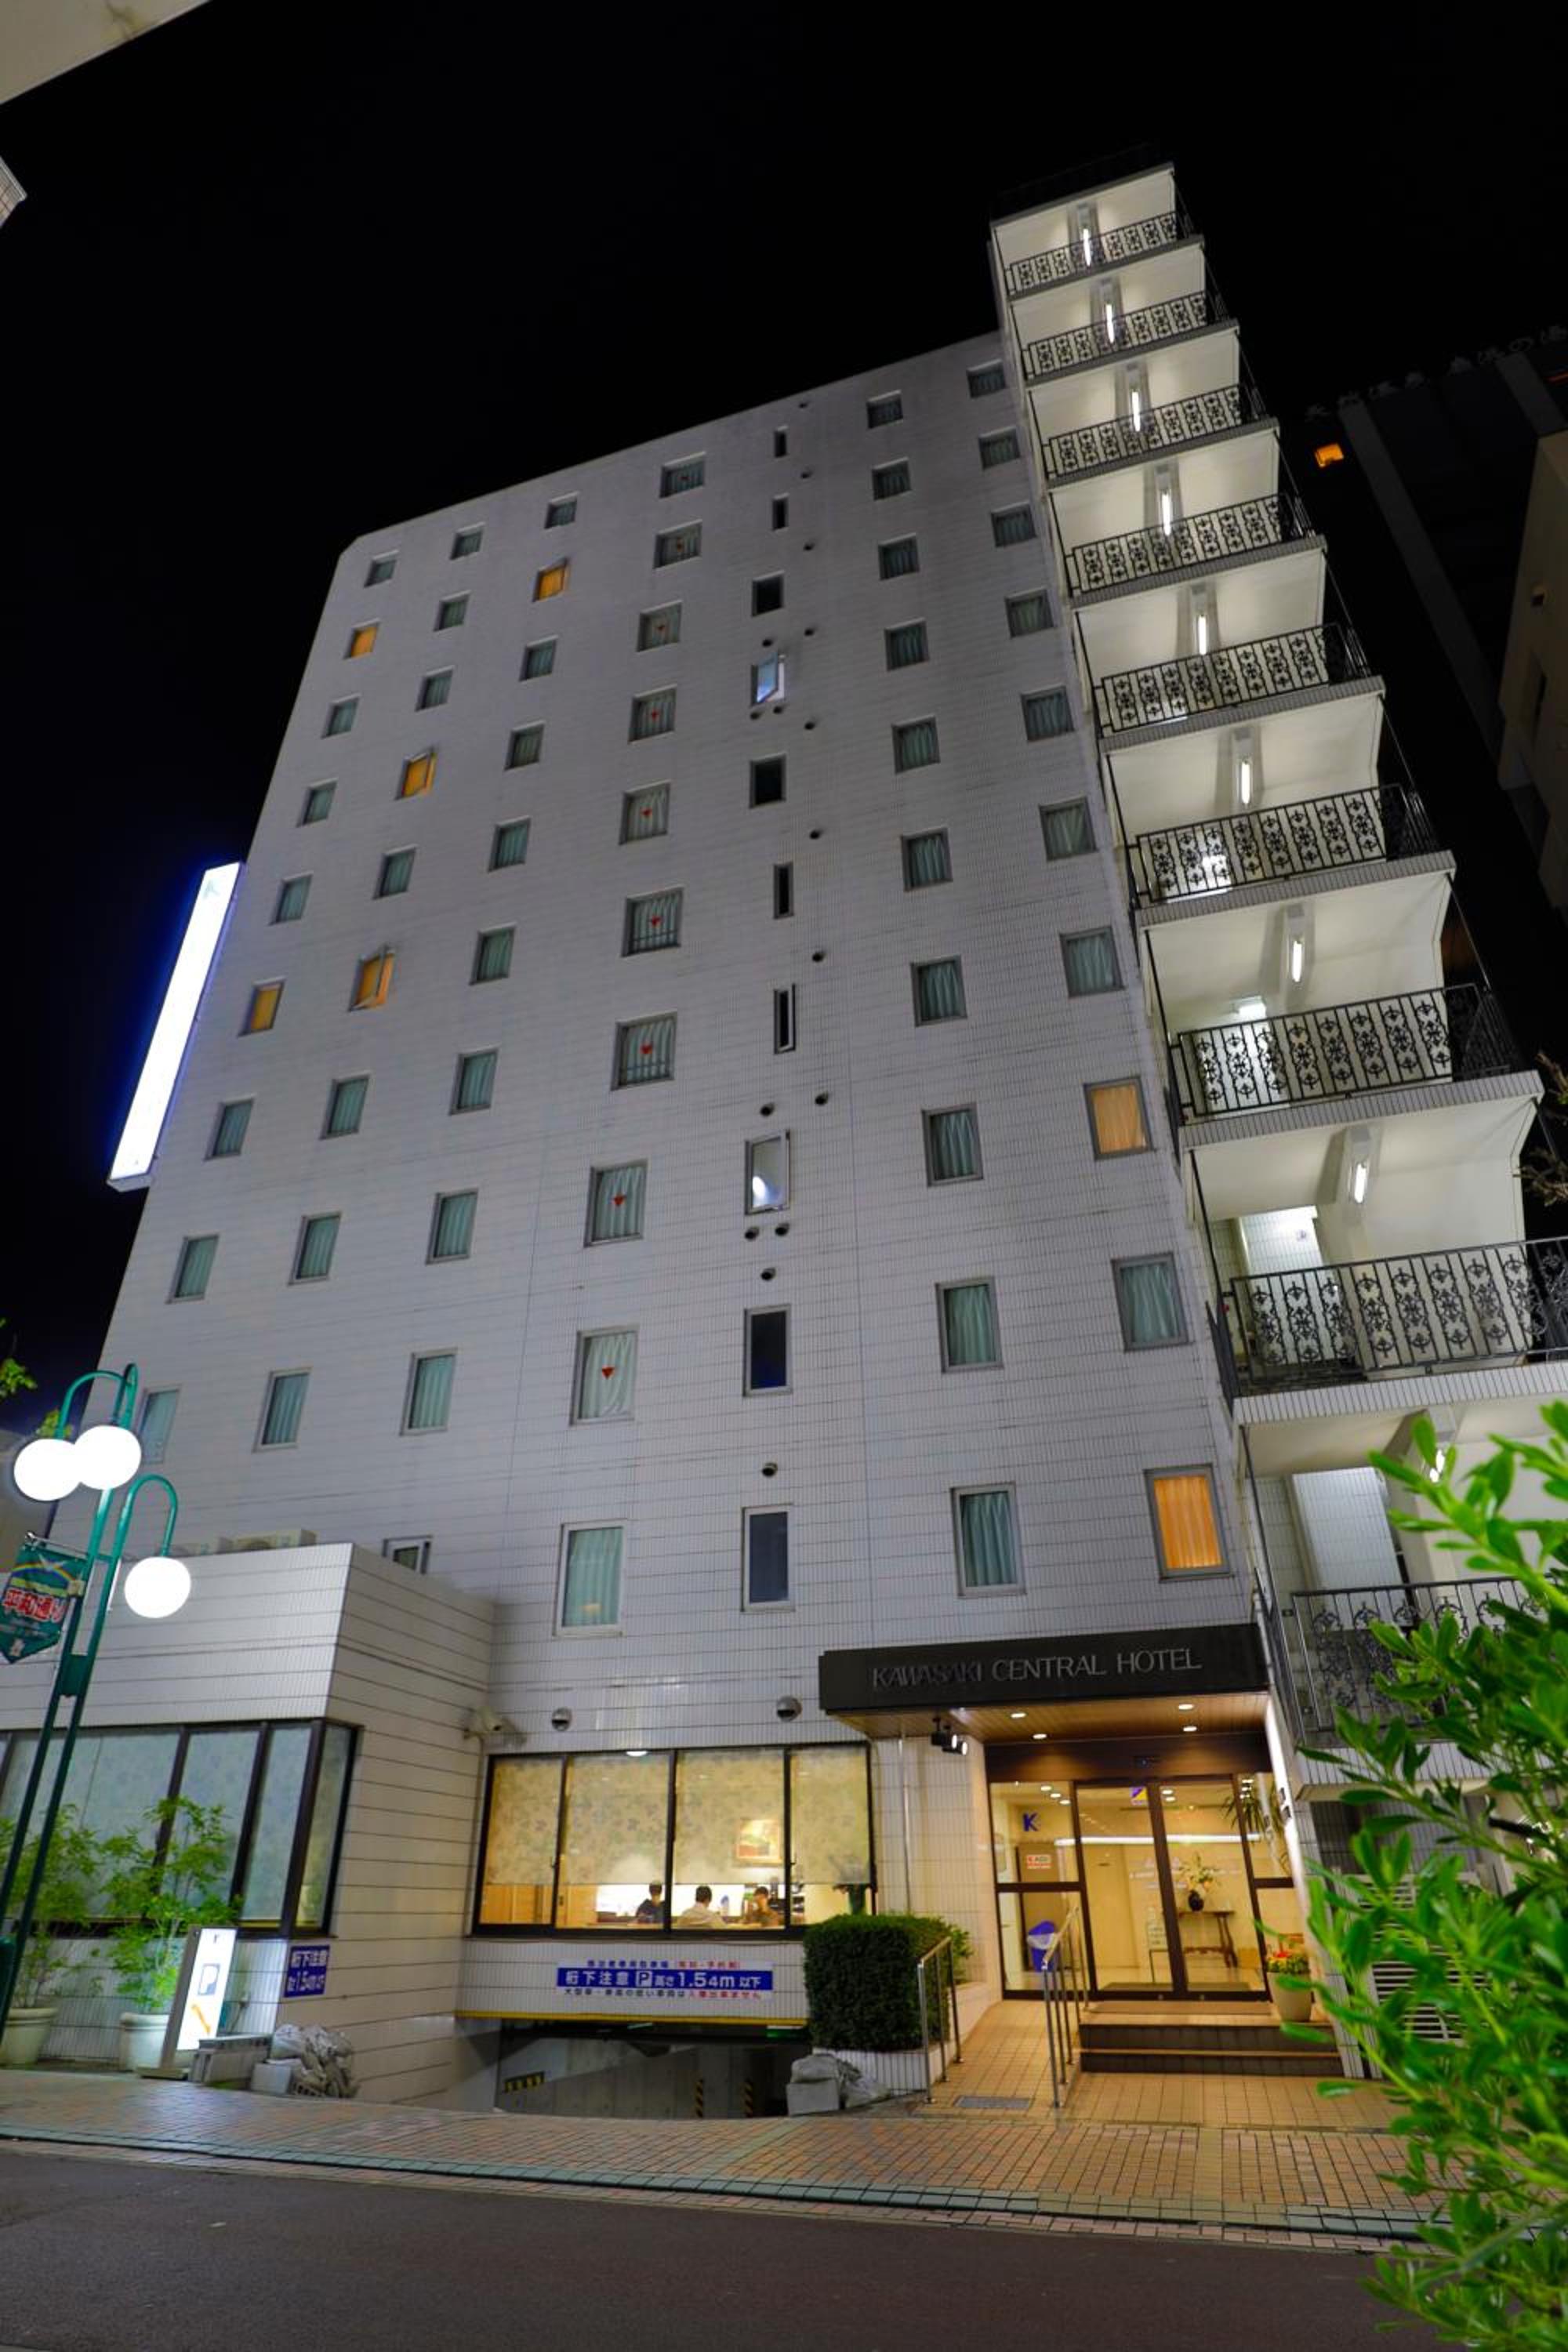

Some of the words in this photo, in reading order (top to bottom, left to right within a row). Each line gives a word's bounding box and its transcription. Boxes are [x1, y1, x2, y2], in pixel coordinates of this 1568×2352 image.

[873, 1661, 982, 1690] KAWASAKI
[992, 1653, 1107, 1682] CENTRAL
[1116, 1647, 1203, 1675] HOTEL
